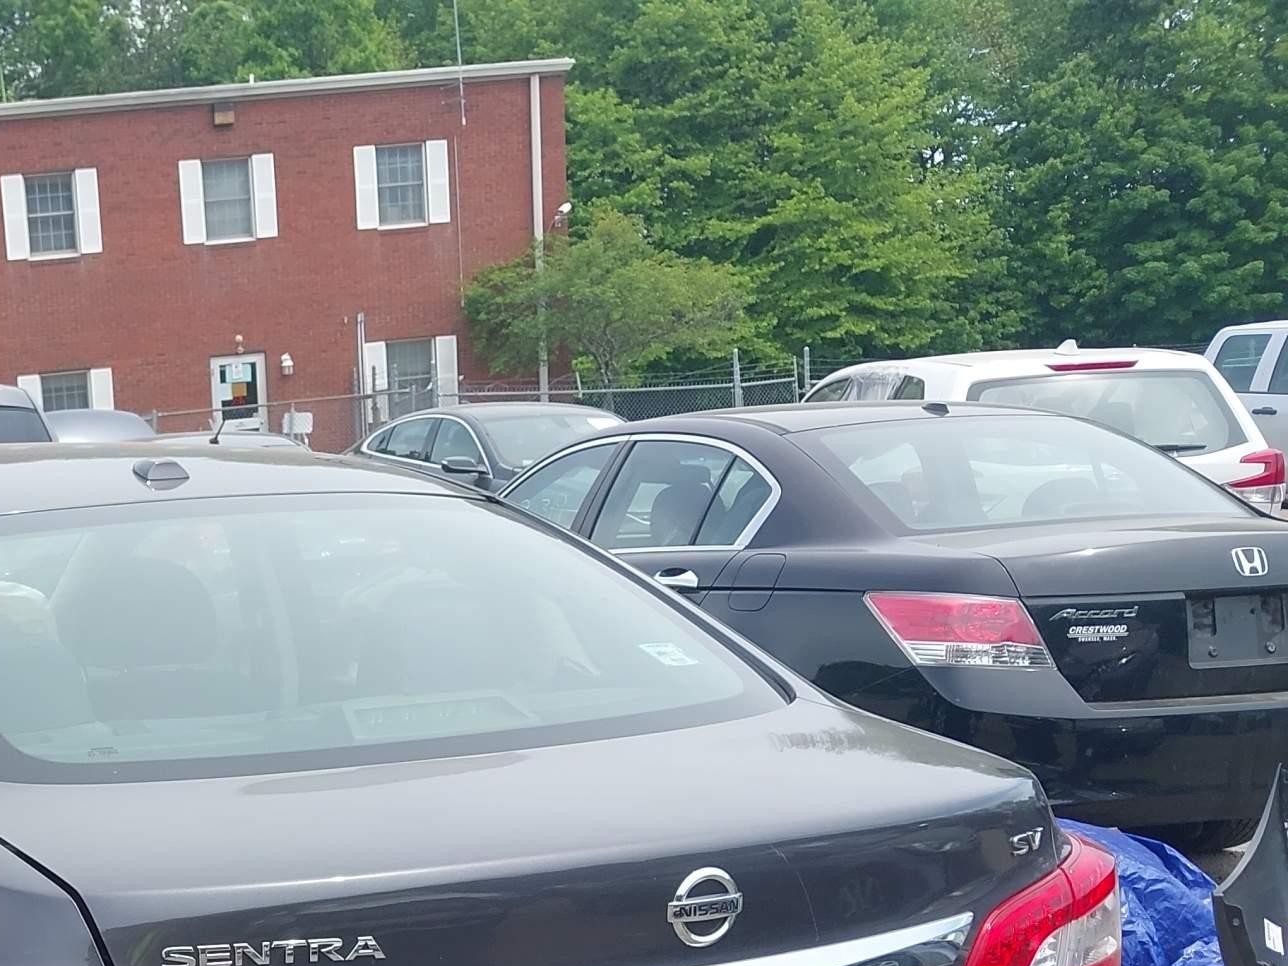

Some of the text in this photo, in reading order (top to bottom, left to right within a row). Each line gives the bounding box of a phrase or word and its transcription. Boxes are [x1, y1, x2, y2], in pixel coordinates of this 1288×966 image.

[1049, 606, 1139, 621] Accord
[1069, 625, 1128, 635] CRESTWOOD
[1010, 827, 1044, 856] SV
[674, 897, 740, 918] NISSAN
